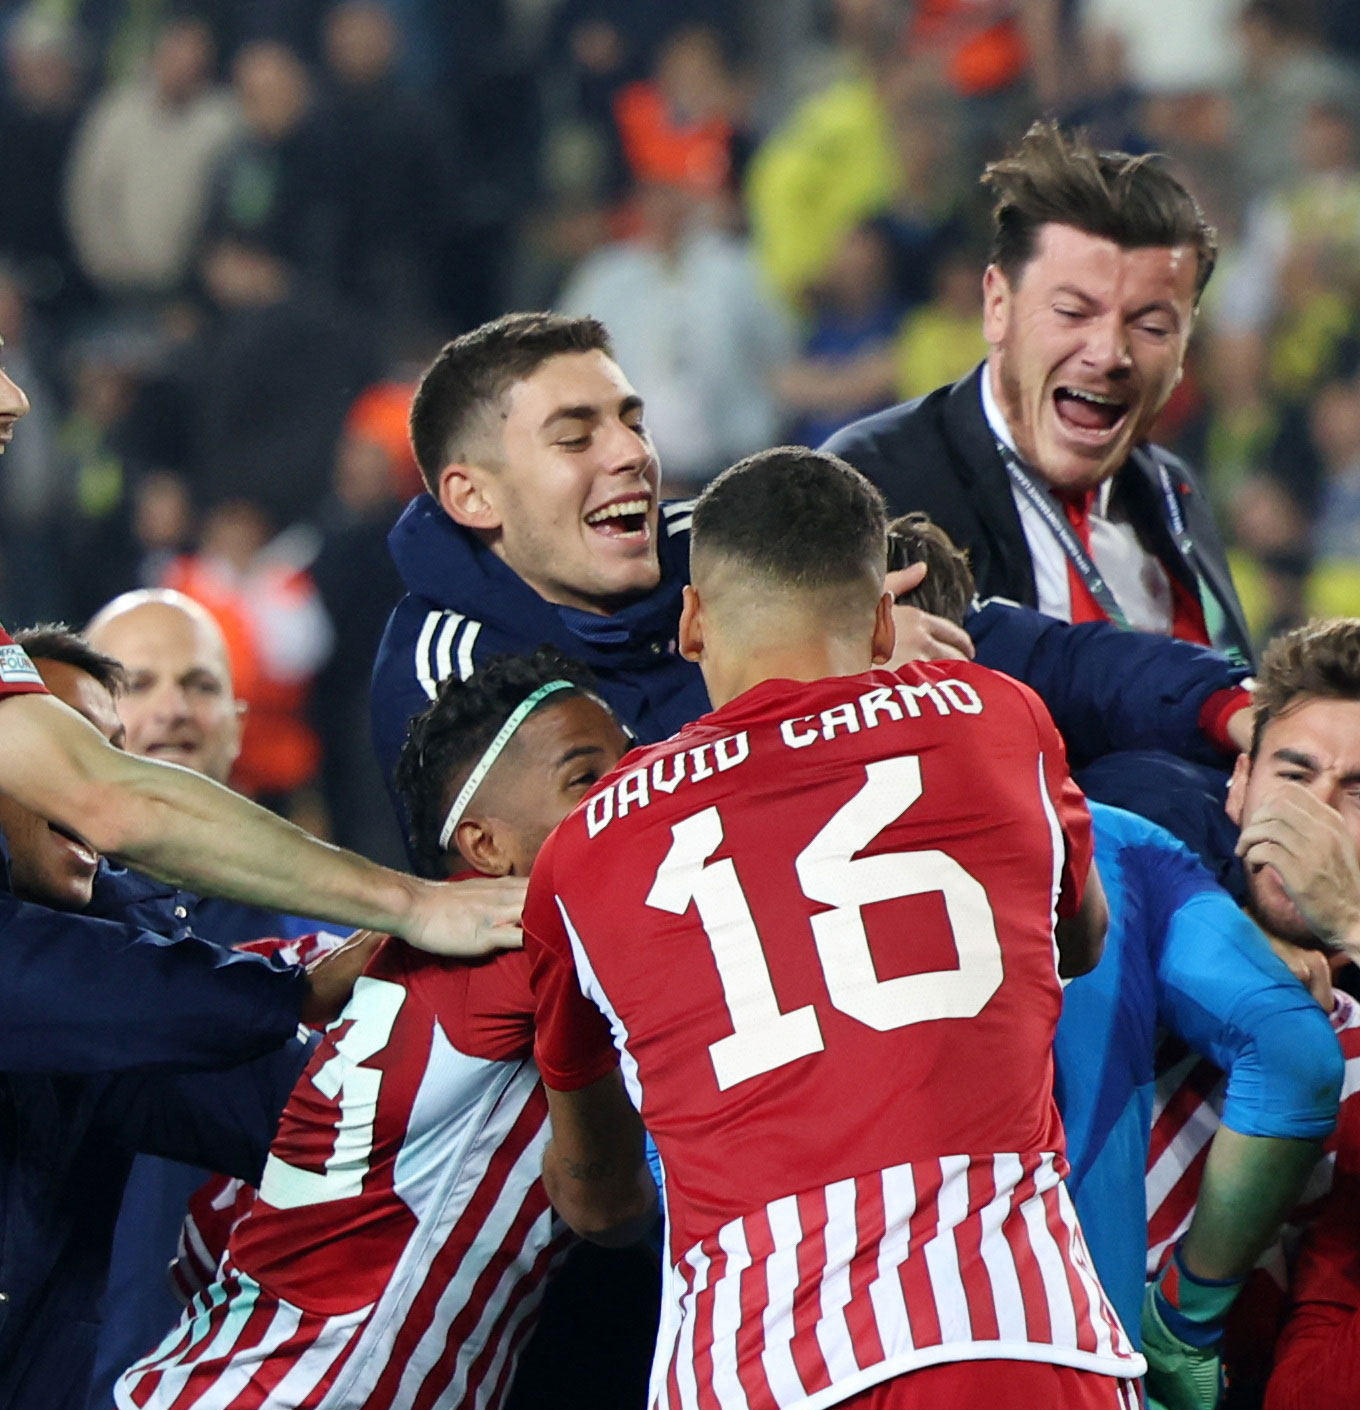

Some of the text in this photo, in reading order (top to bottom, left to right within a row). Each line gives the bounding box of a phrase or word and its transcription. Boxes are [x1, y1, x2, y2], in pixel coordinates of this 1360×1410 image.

[585, 731, 751, 839] DAVID
[779, 678, 983, 750] CARMO
[644, 755, 1004, 1092] 16
